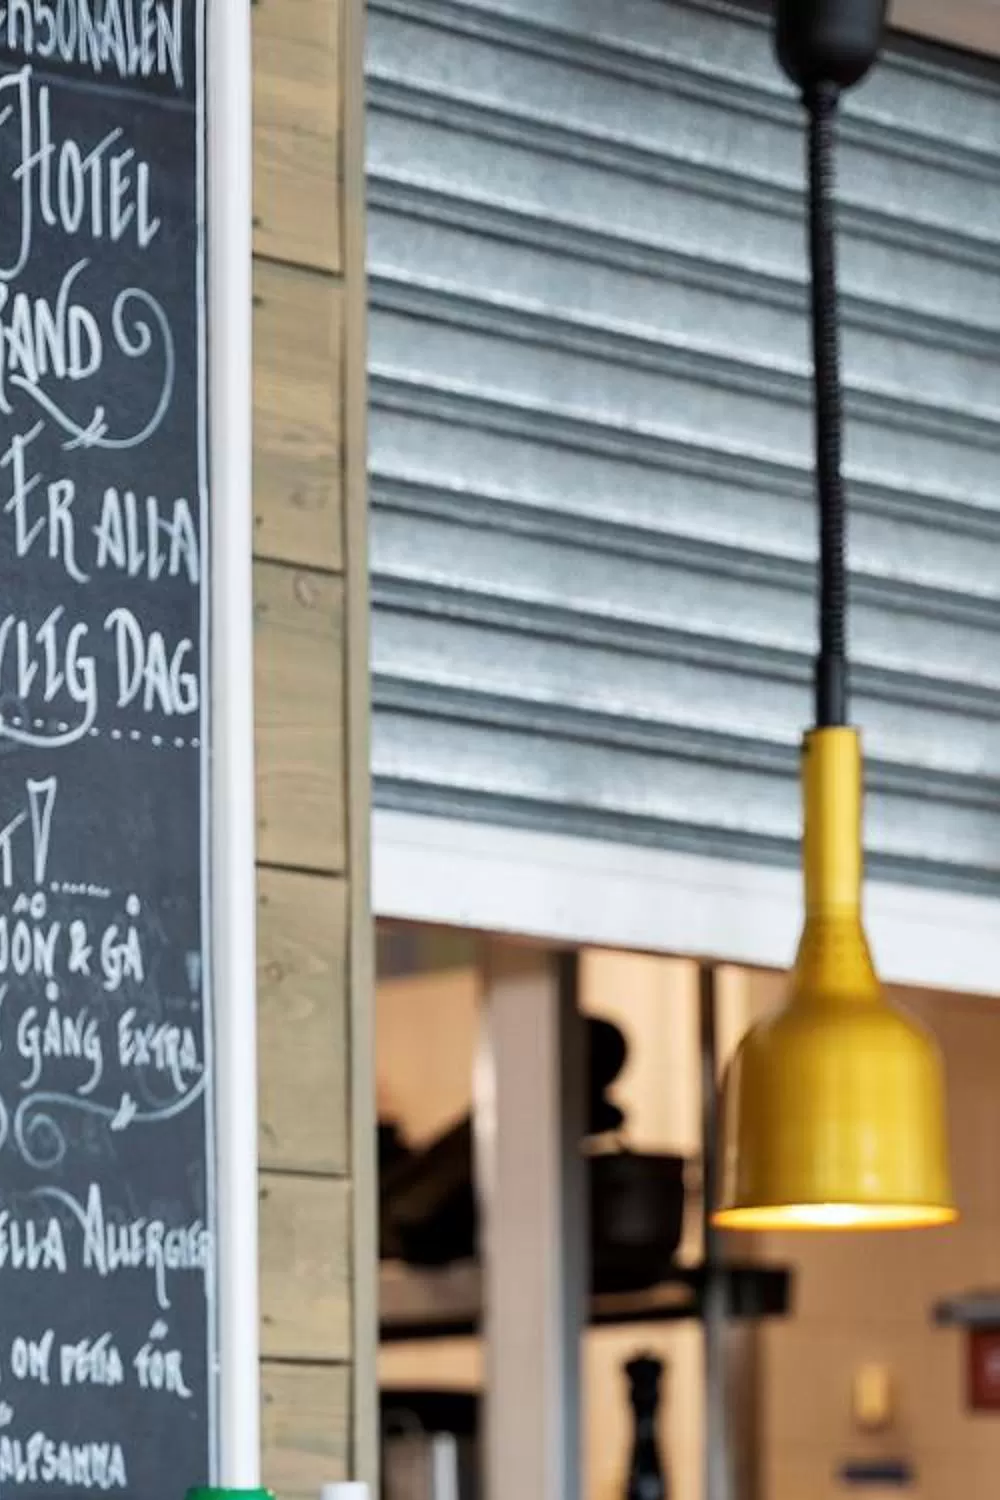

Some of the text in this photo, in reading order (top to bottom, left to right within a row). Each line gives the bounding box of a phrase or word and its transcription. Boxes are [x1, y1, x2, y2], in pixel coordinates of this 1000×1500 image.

[0, 420, 90, 583] ER
[93, 486, 200, 585] ALLA
[104, 607, 199, 716] DAG
[69, 919, 92, 976] &
[101, 893, 144, 991] GÅ
[16, 981, 103, 1094] GÅNG
[132, 1317, 193, 1398] FÖR
